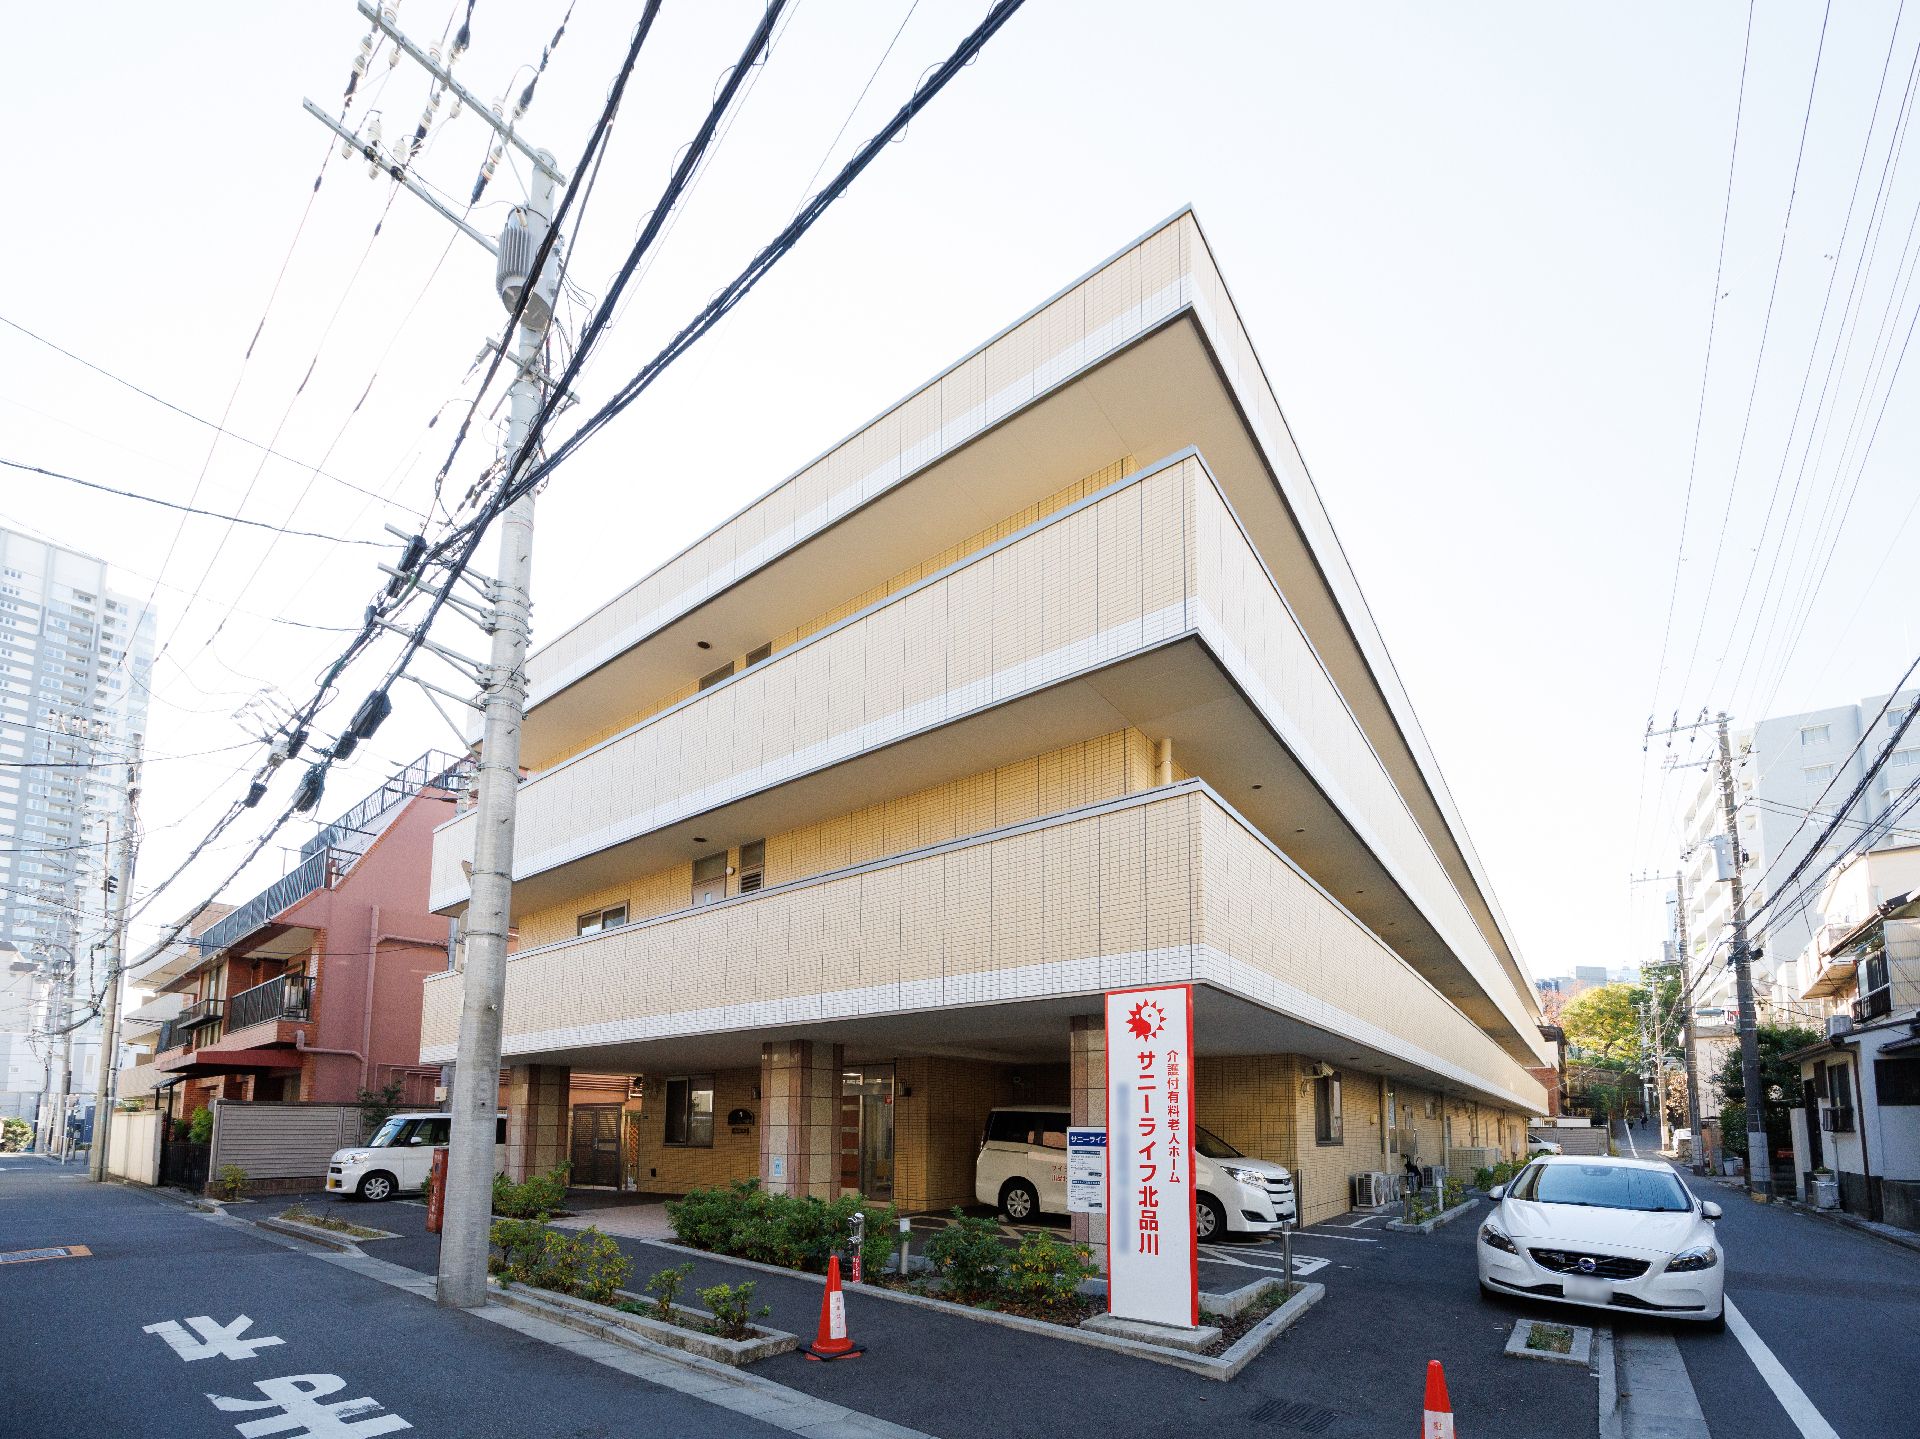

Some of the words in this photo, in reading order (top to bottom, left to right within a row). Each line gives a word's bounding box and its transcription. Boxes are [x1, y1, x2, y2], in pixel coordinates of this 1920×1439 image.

[1137, 1050, 1160, 1257] サニーライフ北品川
[1167, 1049, 1181, 1183] 介護付有料老人ホーム
